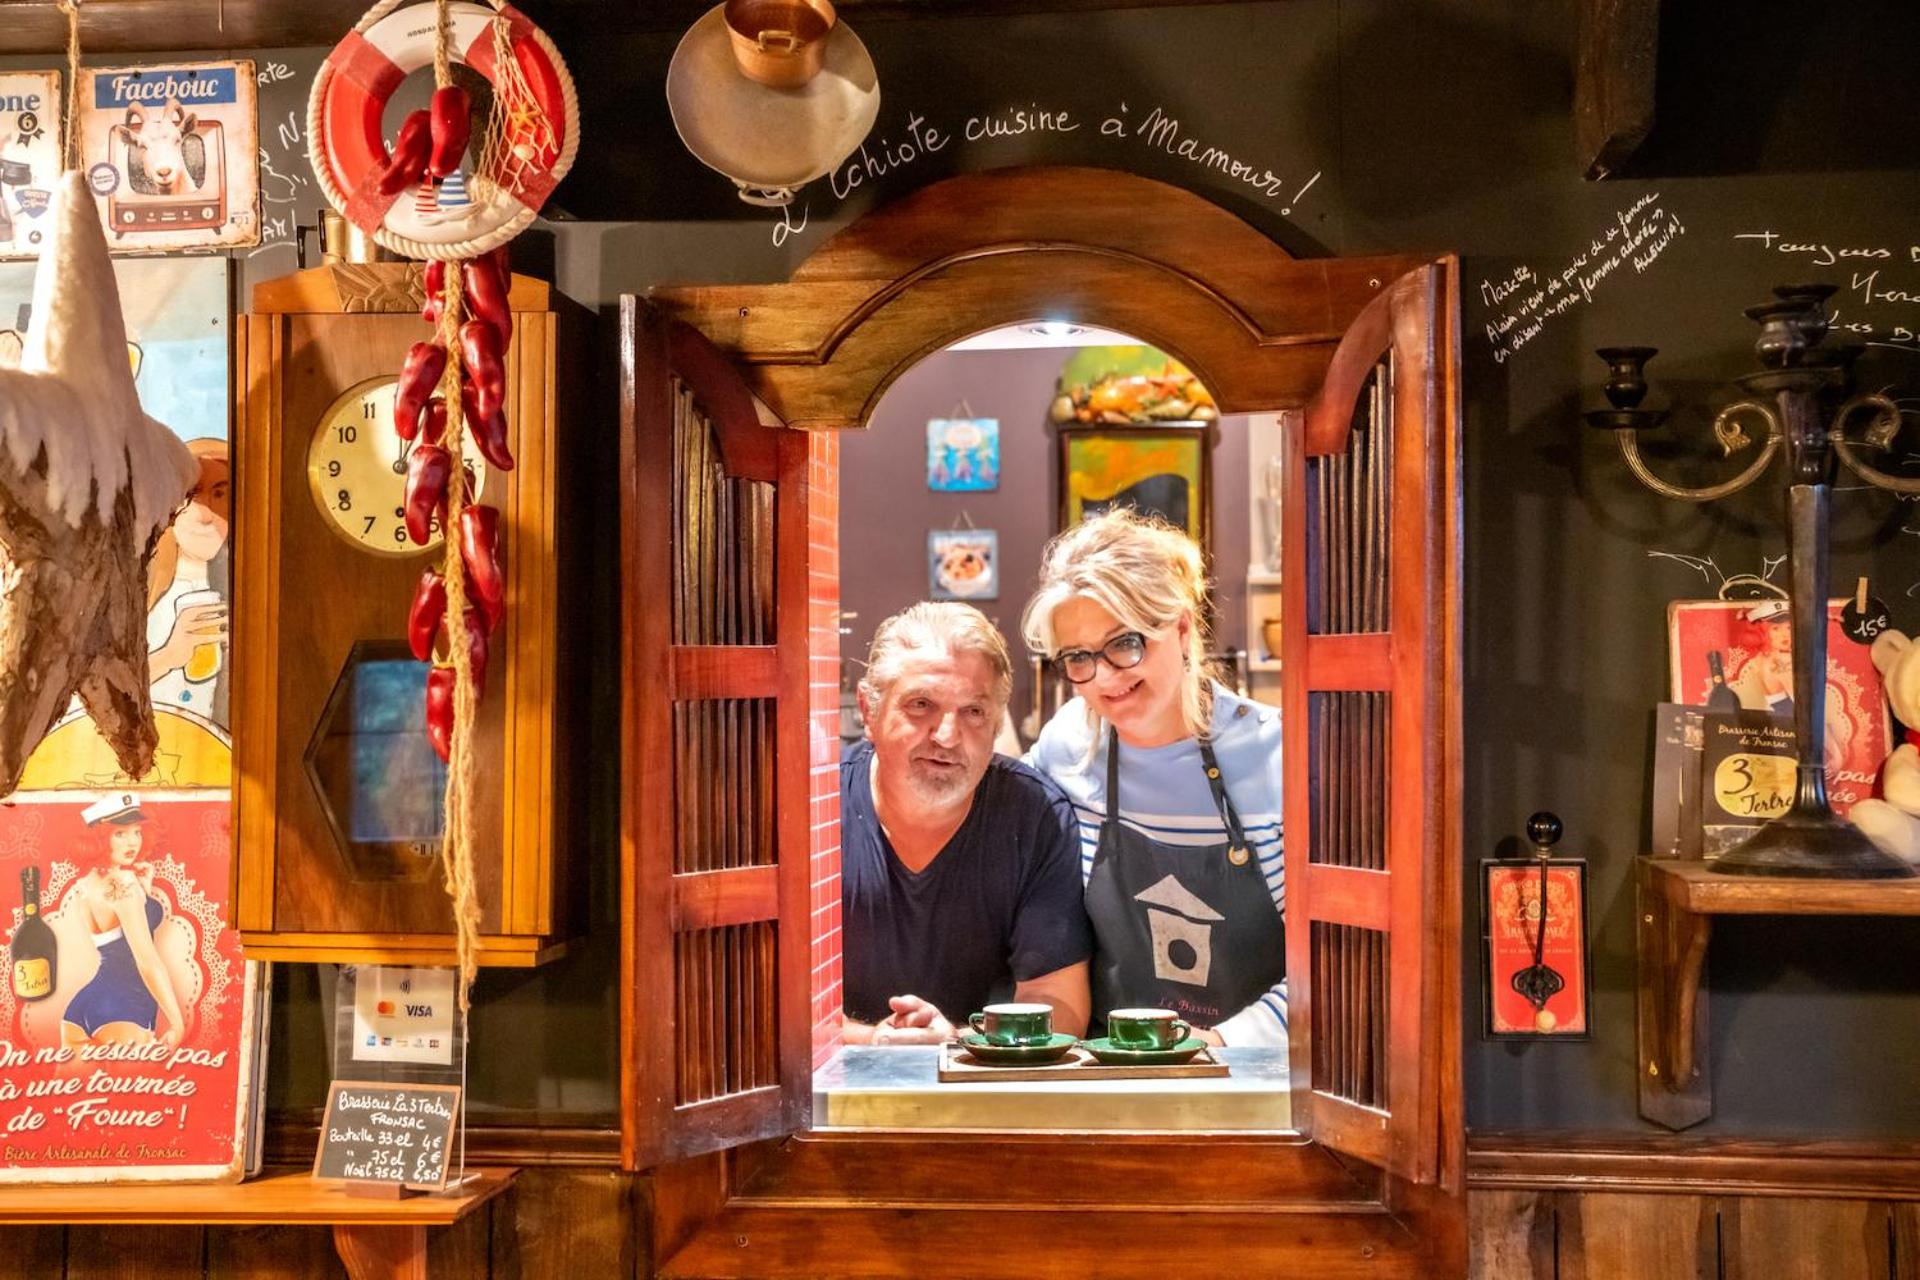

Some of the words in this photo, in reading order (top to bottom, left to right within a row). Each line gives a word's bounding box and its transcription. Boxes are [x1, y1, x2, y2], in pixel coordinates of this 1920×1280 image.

[111, 74, 219, 101] Facebouc
[964, 101, 1081, 142] cuisine
[1100, 101, 1129, 139] à
[1485, 313, 1518, 344] Alain
[1519, 289, 1545, 316] vient
[1547, 277, 1562, 296] de
[1617, 192, 1660, 239] femme
[1494, 347, 1511, 364] en
[1577, 256, 1621, 304] femme
[363, 402, 376, 419] 11
[338, 427, 357, 444] 10
[328, 460, 341, 477] 9
[338, 489, 352, 512] 8
[363, 516, 376, 534] 7
[394, 525, 407, 542] 6
[1760, 726, 1796, 739] Artisan
[1723, 758, 1753, 795] 3
[1832, 770, 1877, 786] pas
[404, 1004, 433, 1018] VISA
[0, 1040, 32, 1067] On
[35, 1045, 74, 1065] ne
[79, 1037, 167, 1062] résiste
[166, 1046, 228, 1070] pas
[0, 1078, 22, 1100] à
[26, 1076, 83, 1098] une
[86, 1069, 198, 1097] tournée
[7, 1105, 47, 1133] de
[369, 1111, 427, 1130] FRONSAC
[329, 1127, 375, 1143] Bouteille
[5, 1145, 38, 1161] Bière
[116, 1144, 131, 1159] de
[136, 1143, 189, 1160] Fronsac
[343, 1162, 373, 1178] Noël
